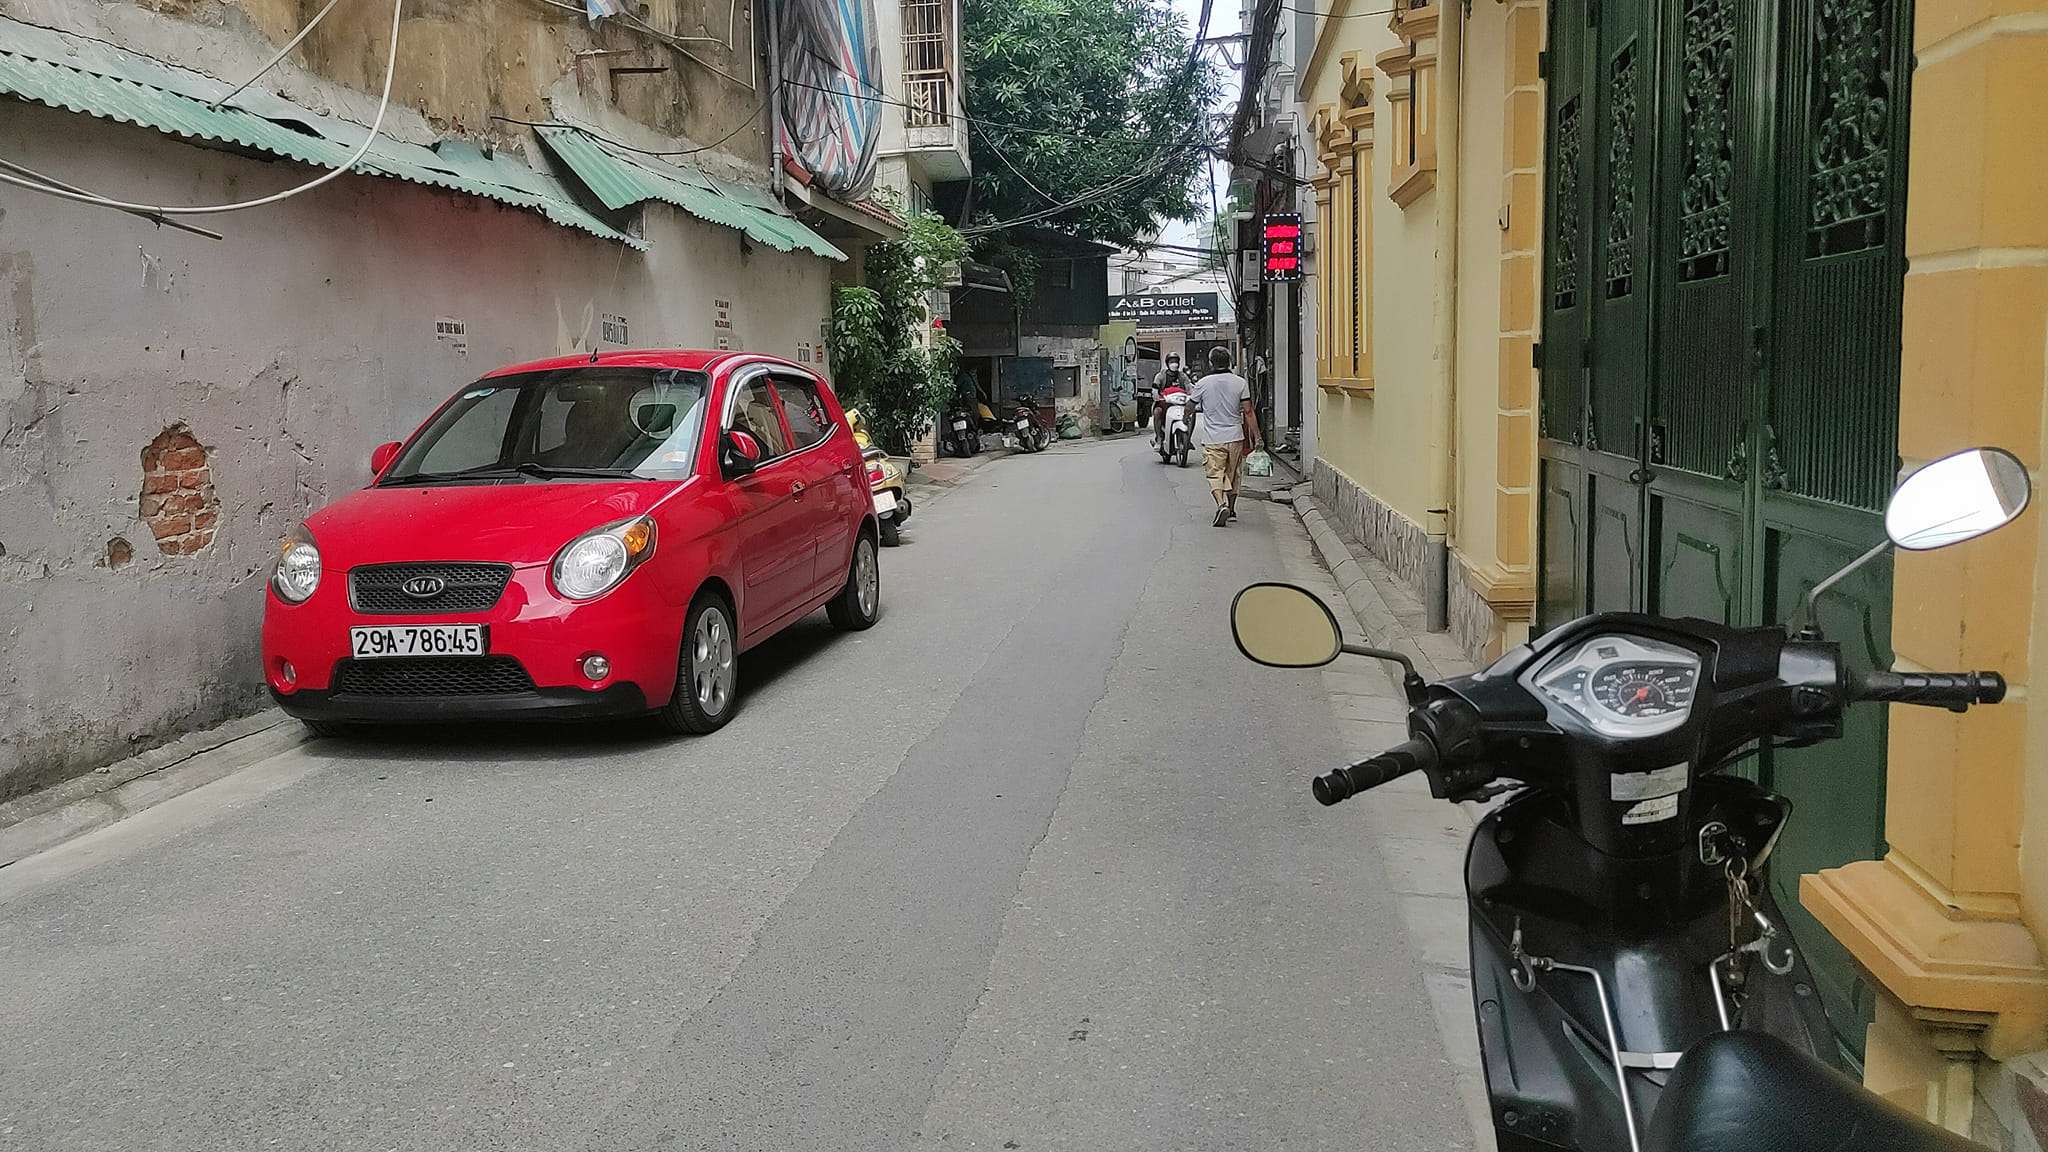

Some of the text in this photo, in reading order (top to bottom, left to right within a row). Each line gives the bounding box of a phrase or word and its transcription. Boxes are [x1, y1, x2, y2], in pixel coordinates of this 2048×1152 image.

[1274, 269, 1285, 278] 21
[1115, 297, 1195, 308] A&B outlet
[409, 579, 438, 592] KIA
